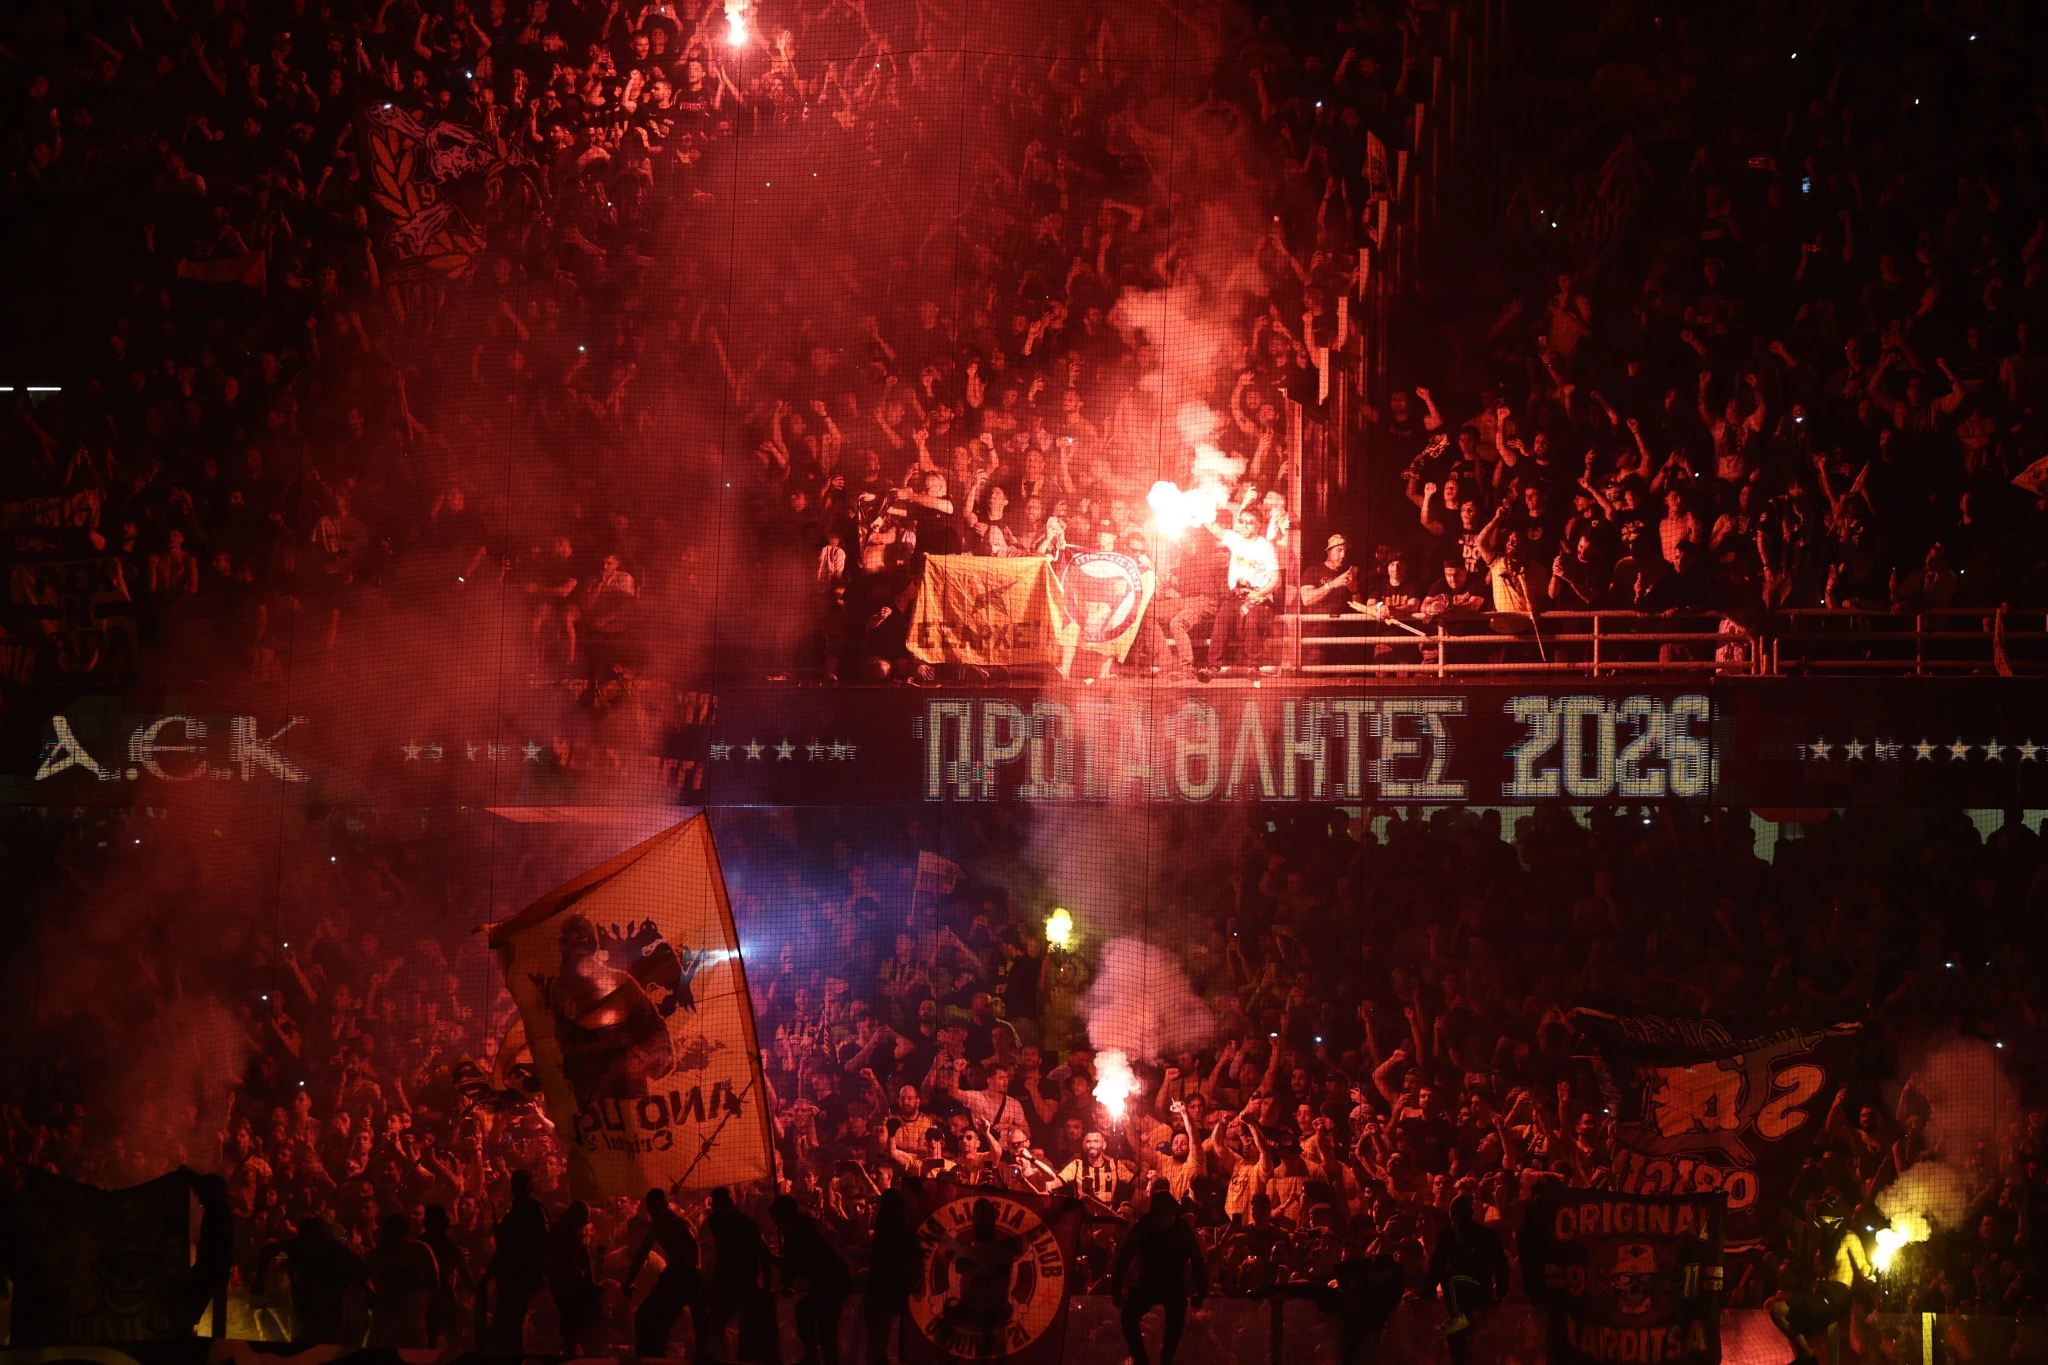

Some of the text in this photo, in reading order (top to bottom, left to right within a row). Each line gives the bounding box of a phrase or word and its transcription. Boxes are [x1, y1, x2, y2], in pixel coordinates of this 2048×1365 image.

[1074, 553, 1141, 591] ΤΙΦΑΣΙΣΤΙΚΗ
[925, 695, 1718, 801] ΠΡΩΤΑΘΛΗΤΕΣ 2026
[1554, 1203, 1711, 1241] ORIGINAL
